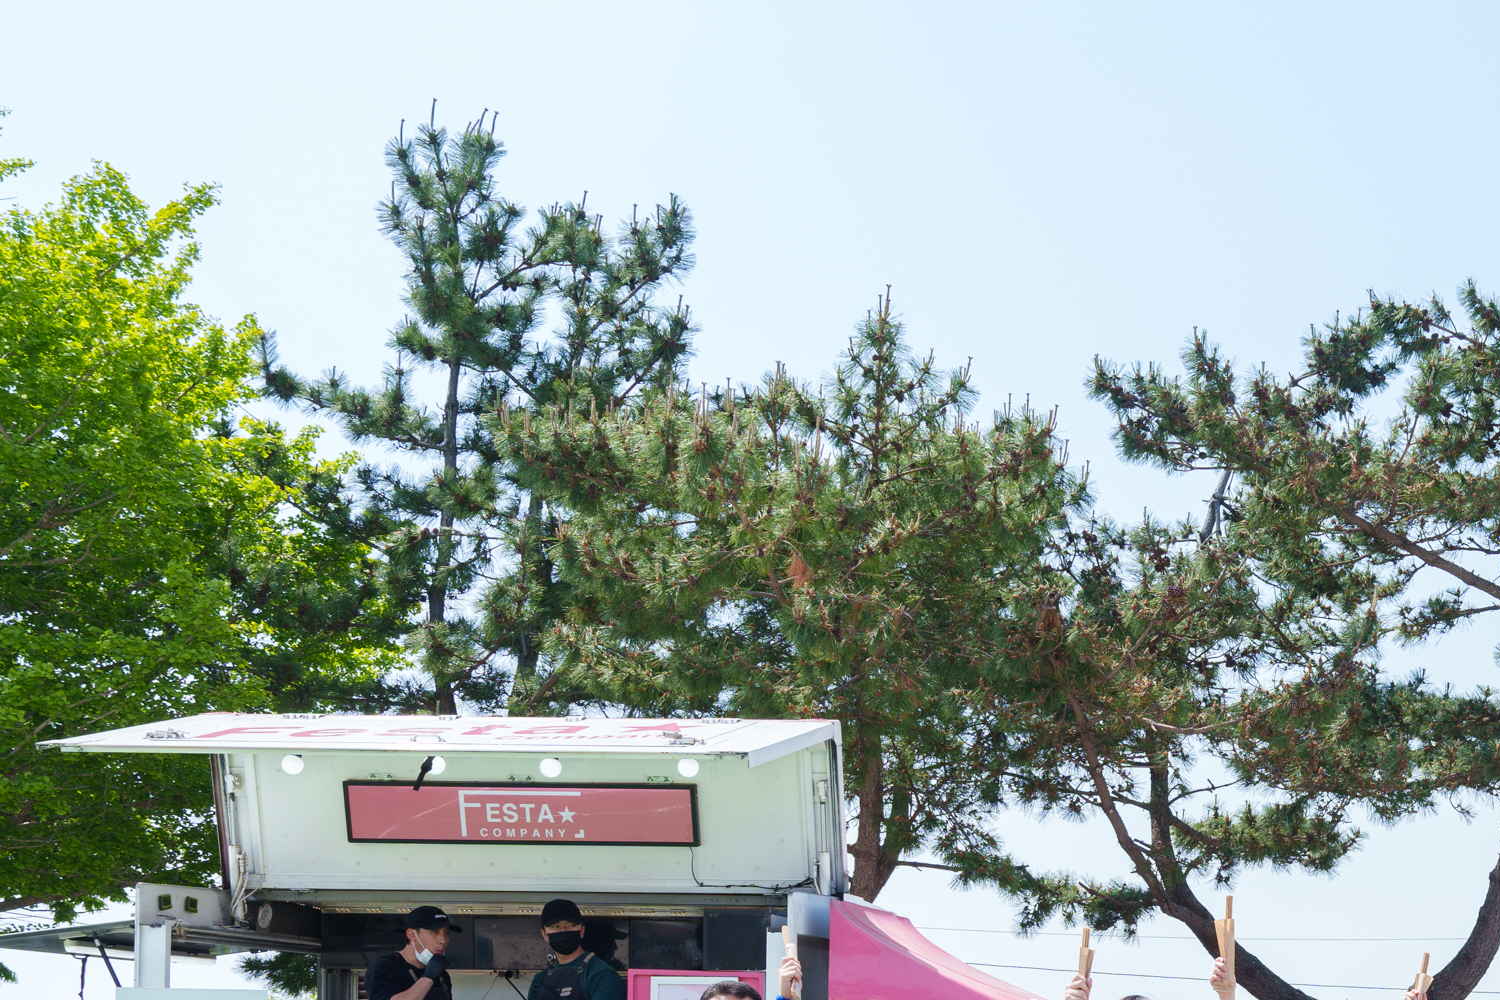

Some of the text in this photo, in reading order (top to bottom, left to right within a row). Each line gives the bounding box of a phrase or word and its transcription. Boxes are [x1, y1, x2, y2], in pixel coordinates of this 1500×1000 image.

[494, 731, 688, 741] Compan
[458, 790, 581, 837] FESTA
[479, 828, 566, 838] COMPANY
